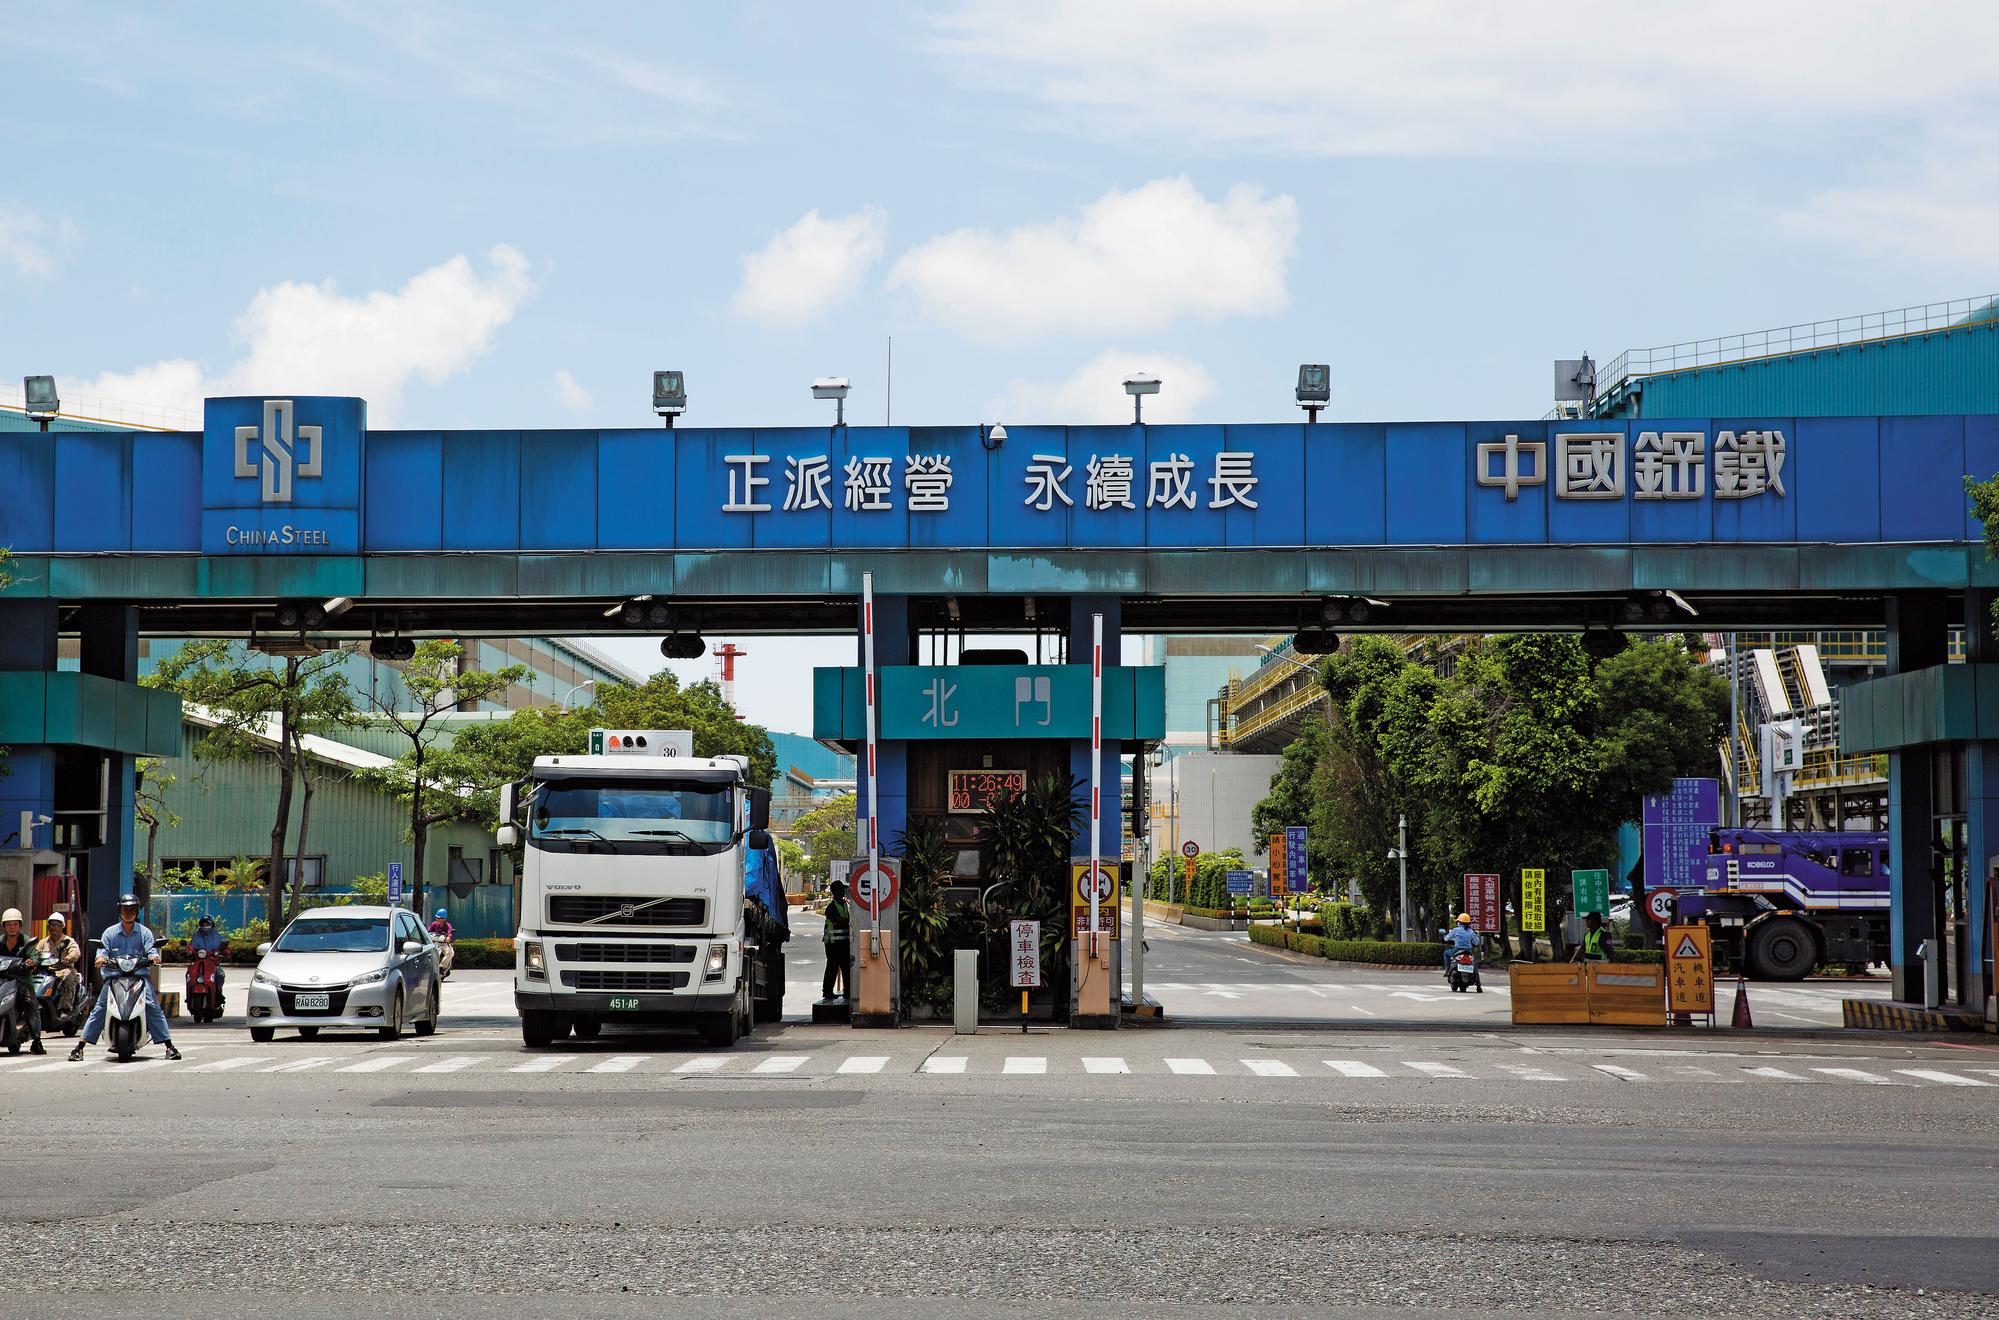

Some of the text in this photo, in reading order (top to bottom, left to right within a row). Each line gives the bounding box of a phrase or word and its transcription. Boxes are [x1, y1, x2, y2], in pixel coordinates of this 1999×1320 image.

[721, 451, 1259, 512] 正派經營 永續成長
[1476, 430, 1786, 502] 中國鋼鐵
[922, 675, 1052, 728] 北門
[953, 774, 1022, 791] 11:26:49
[1747, 861, 1775, 869] KOBELCO
[1524, 870, 1533, 930] 請依速限行駛
[1673, 962, 1687, 1002] 汽車道
